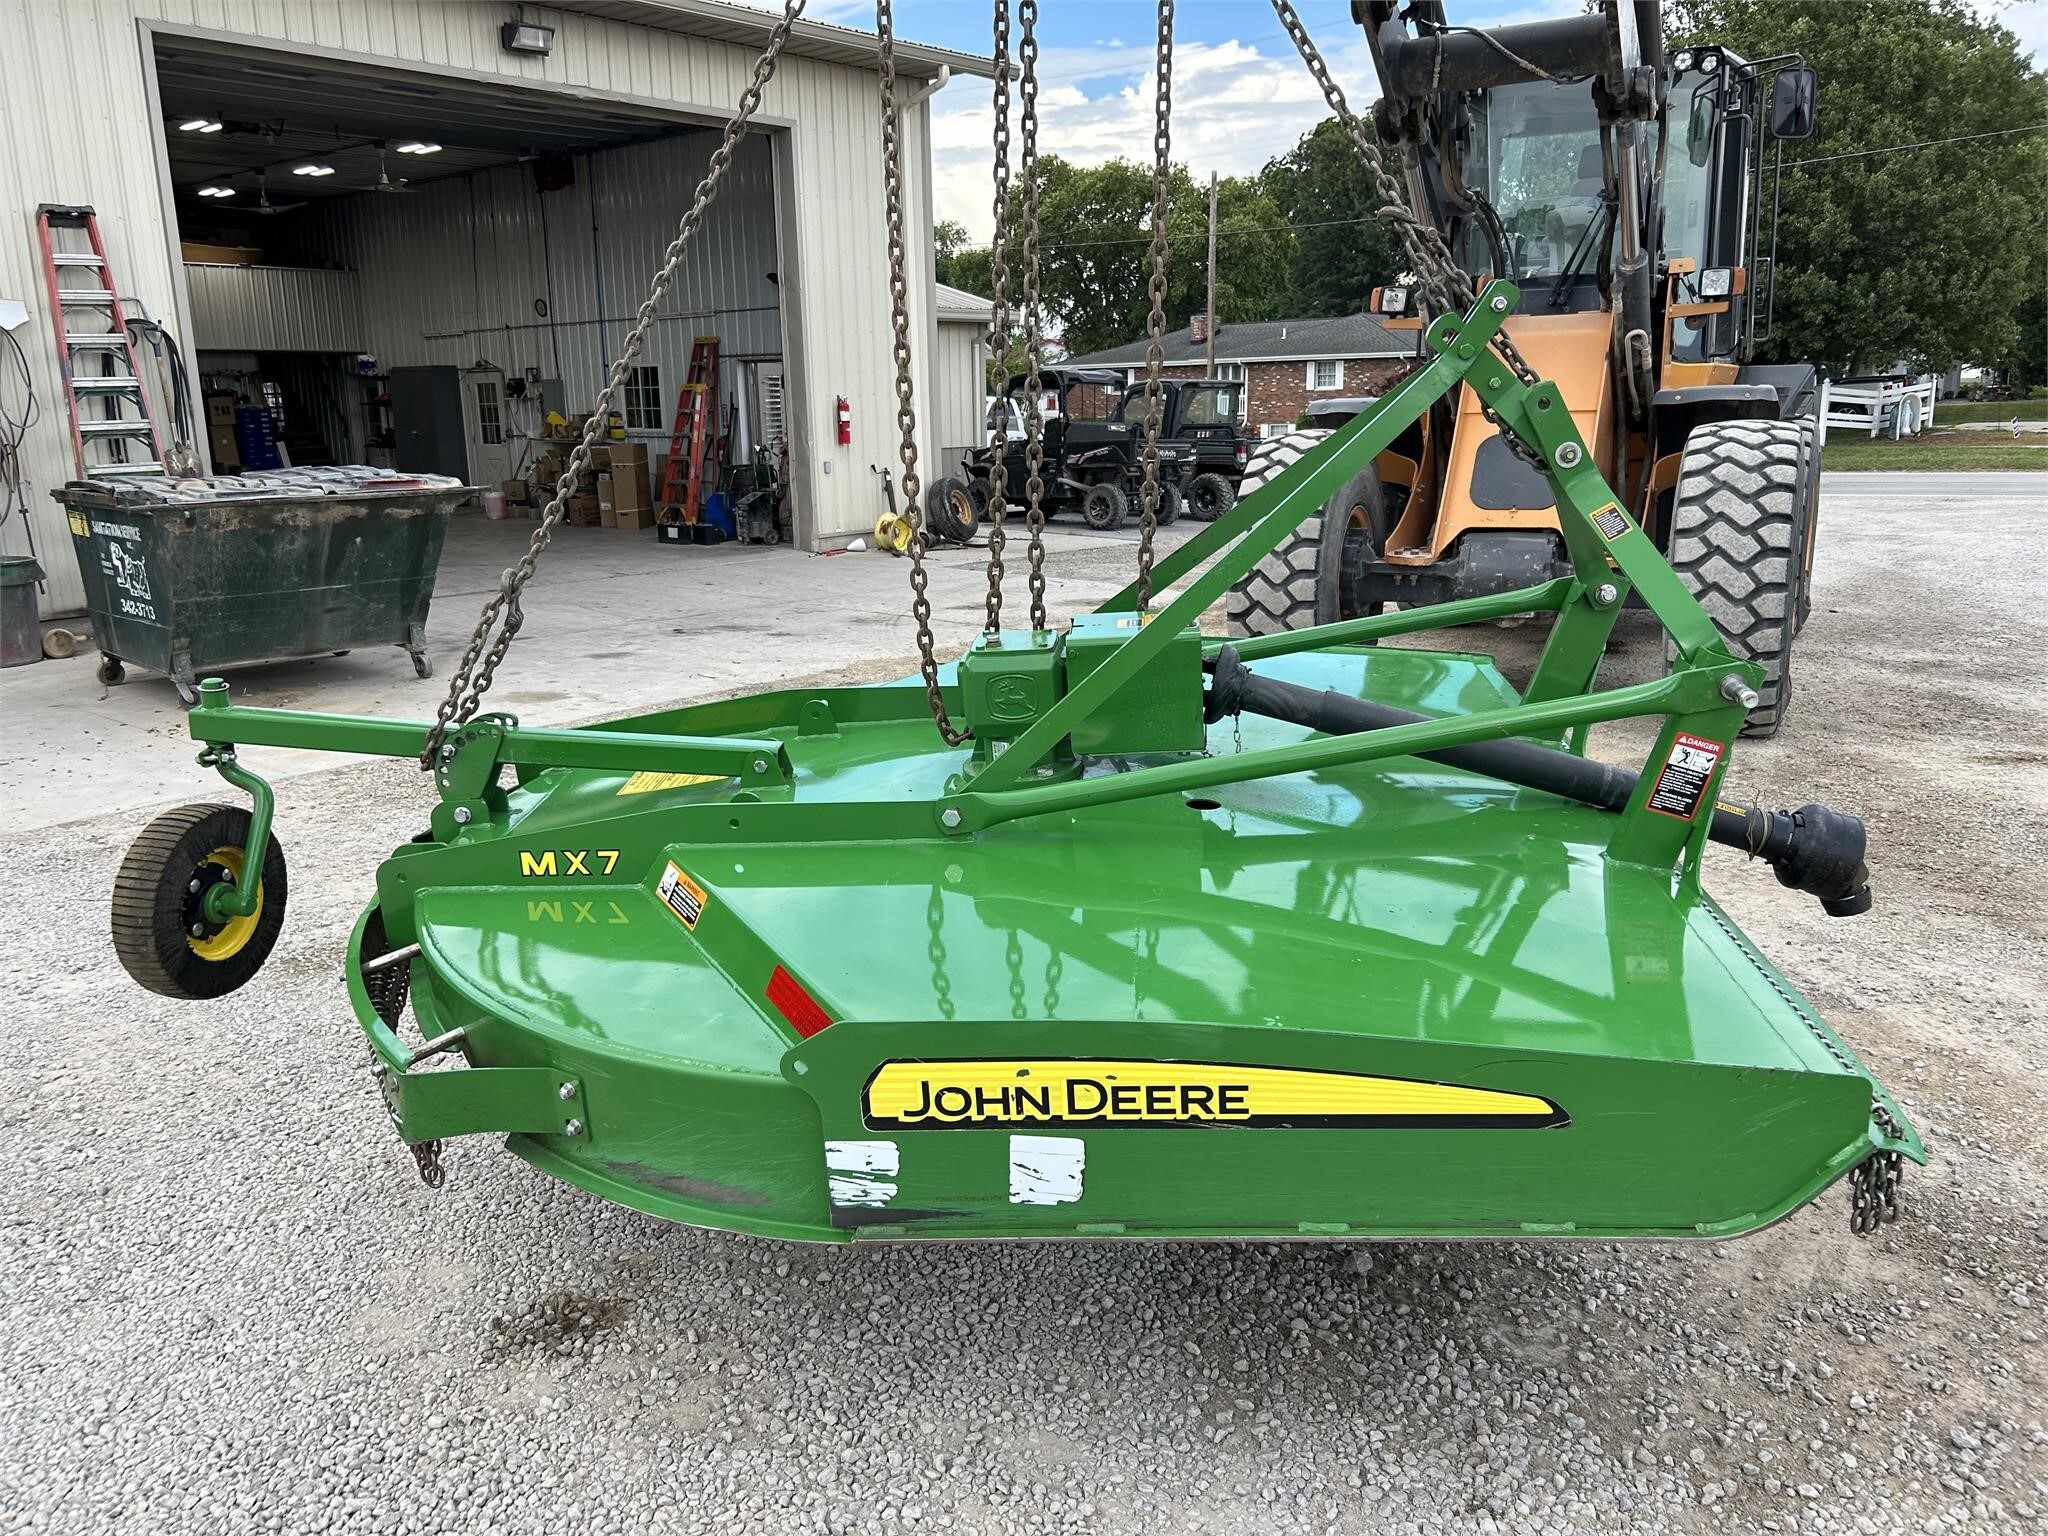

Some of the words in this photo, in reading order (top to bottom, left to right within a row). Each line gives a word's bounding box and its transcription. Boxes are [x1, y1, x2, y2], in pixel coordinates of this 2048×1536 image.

[120, 599, 156, 620] 342-3713
[1686, 738, 1720, 752] DANGER
[903, 1080, 1051, 1117] JOHN
[1066, 1079, 1250, 1116] DEERE
